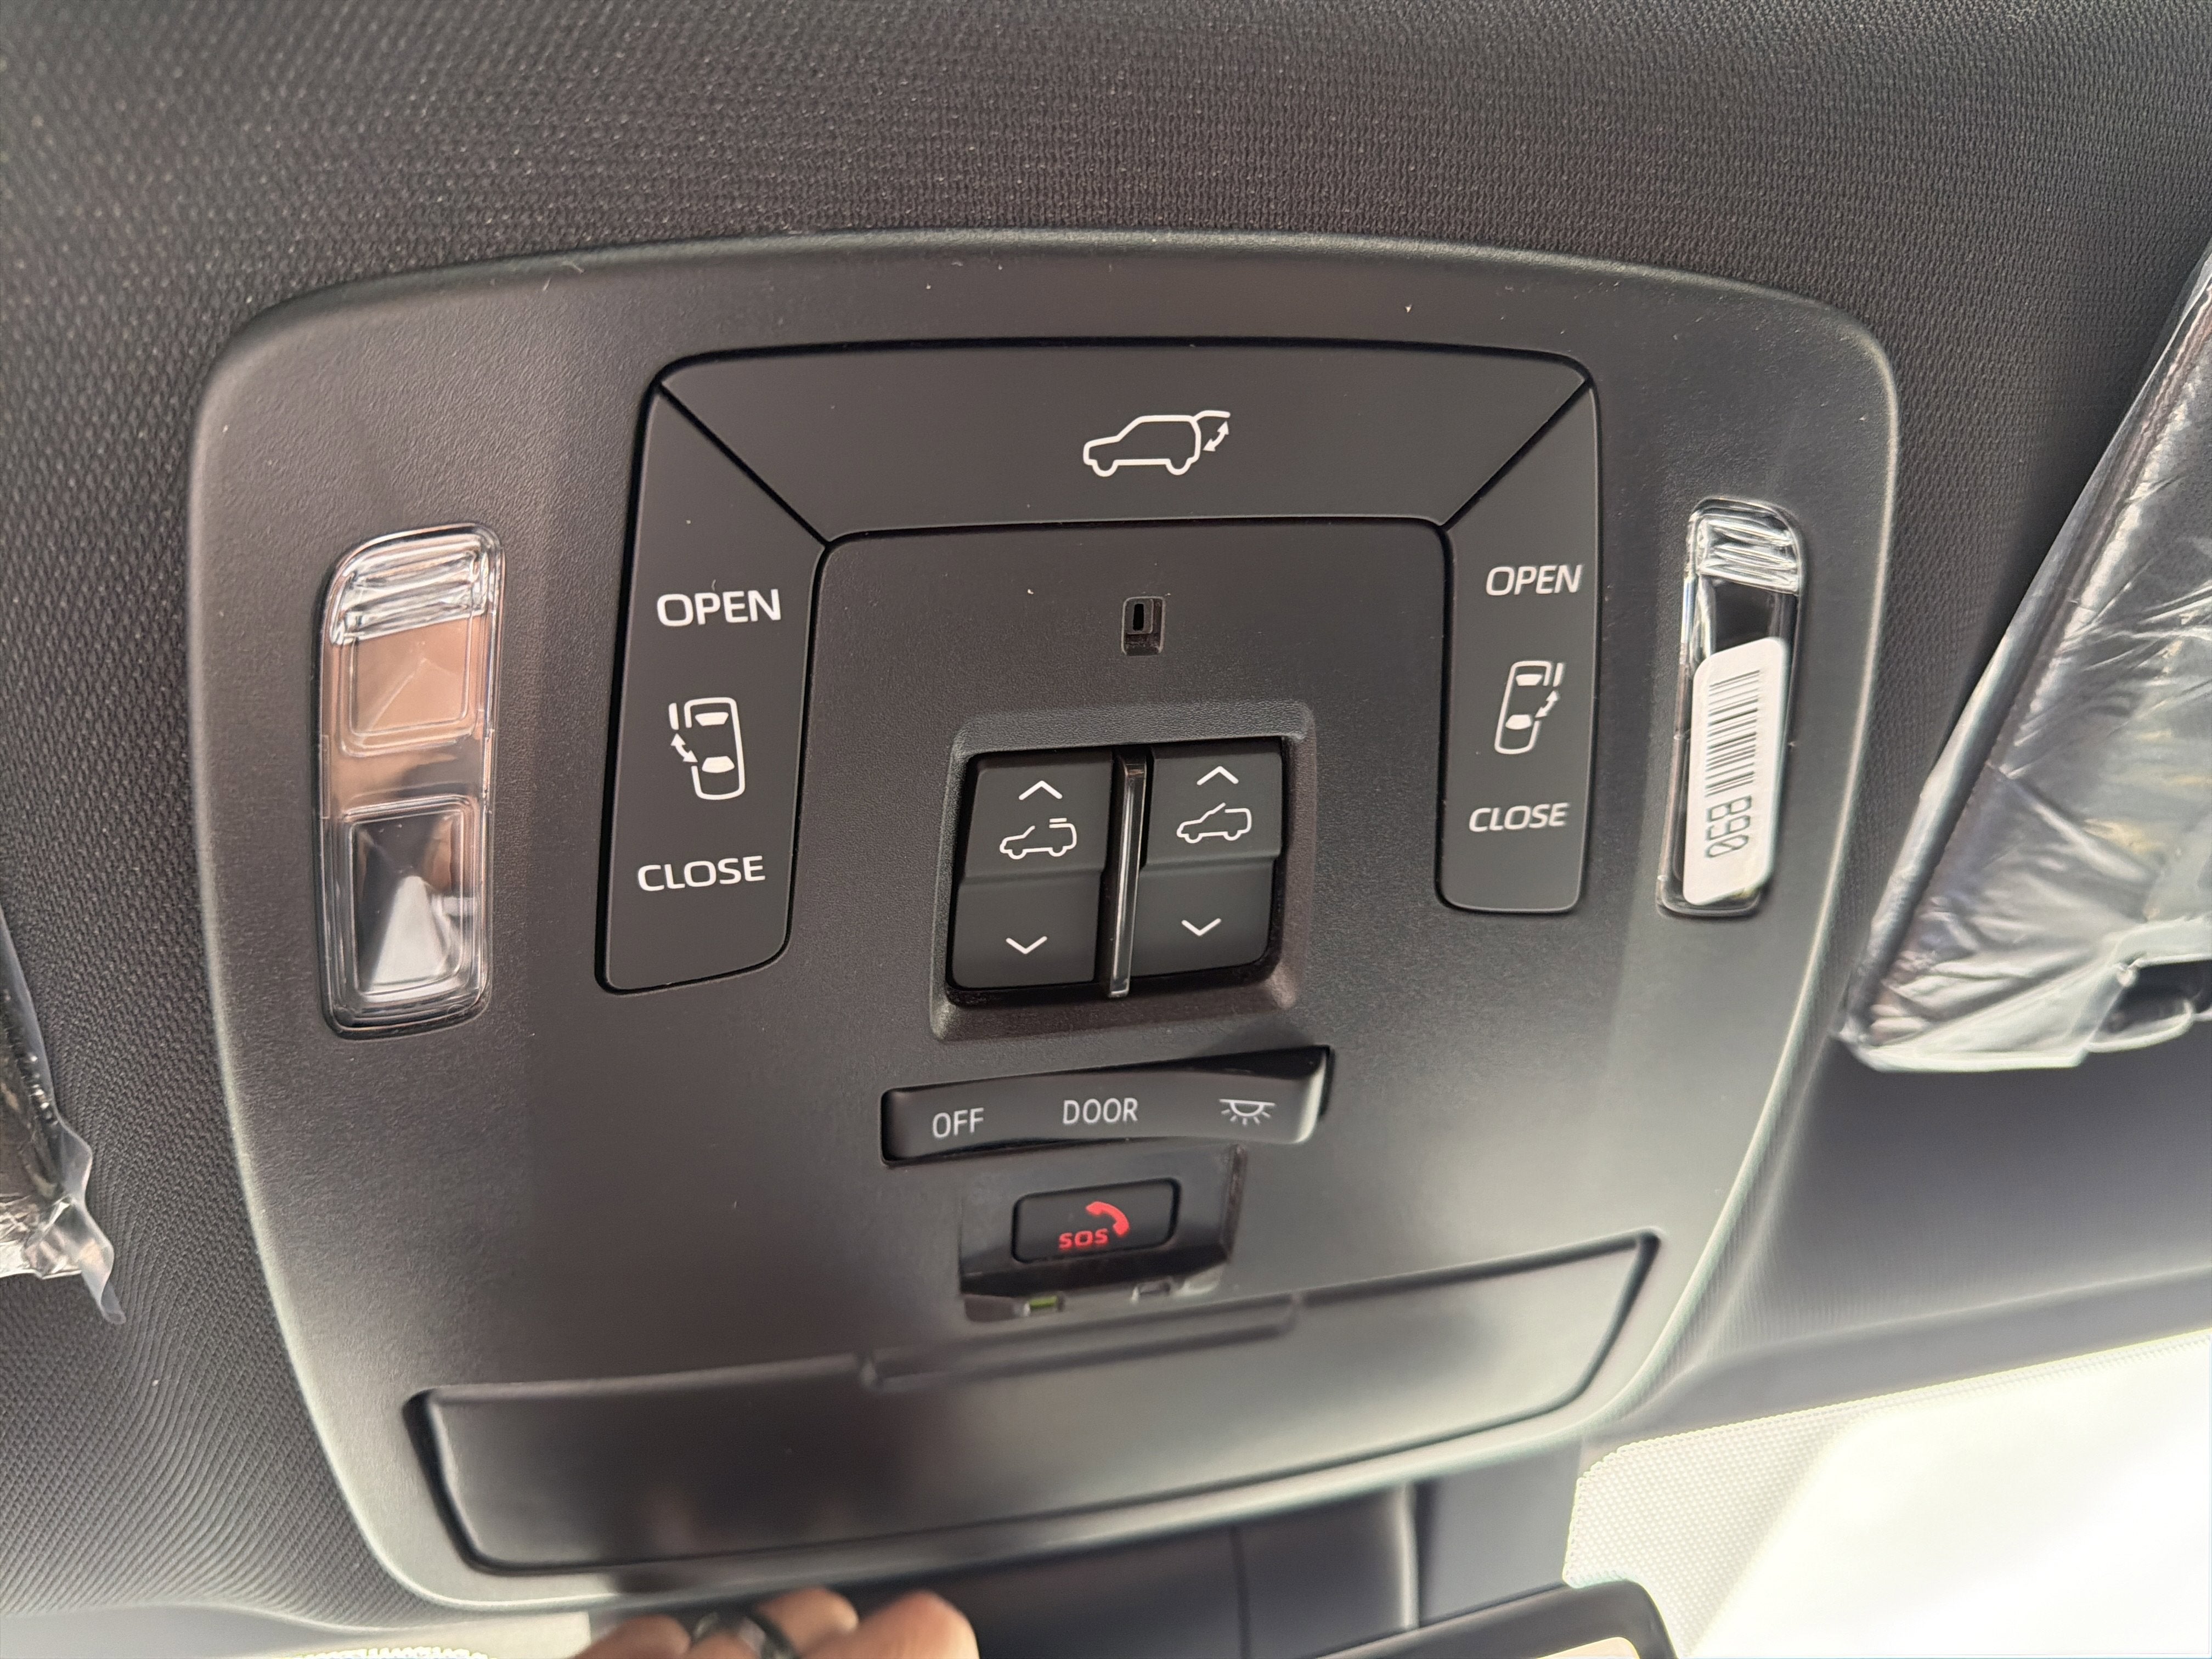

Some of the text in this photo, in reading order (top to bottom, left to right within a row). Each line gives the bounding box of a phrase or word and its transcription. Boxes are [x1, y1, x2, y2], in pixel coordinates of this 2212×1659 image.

[1486, 563, 1584, 596] OPEN
[656, 588, 782, 627] OPEN
[1469, 802, 1570, 833] CLOSE
[637, 855, 766, 892] CLOSE
[932, 1097, 1138, 1140] OFF DOOR
[1059, 1228, 1109, 1250] SOS
